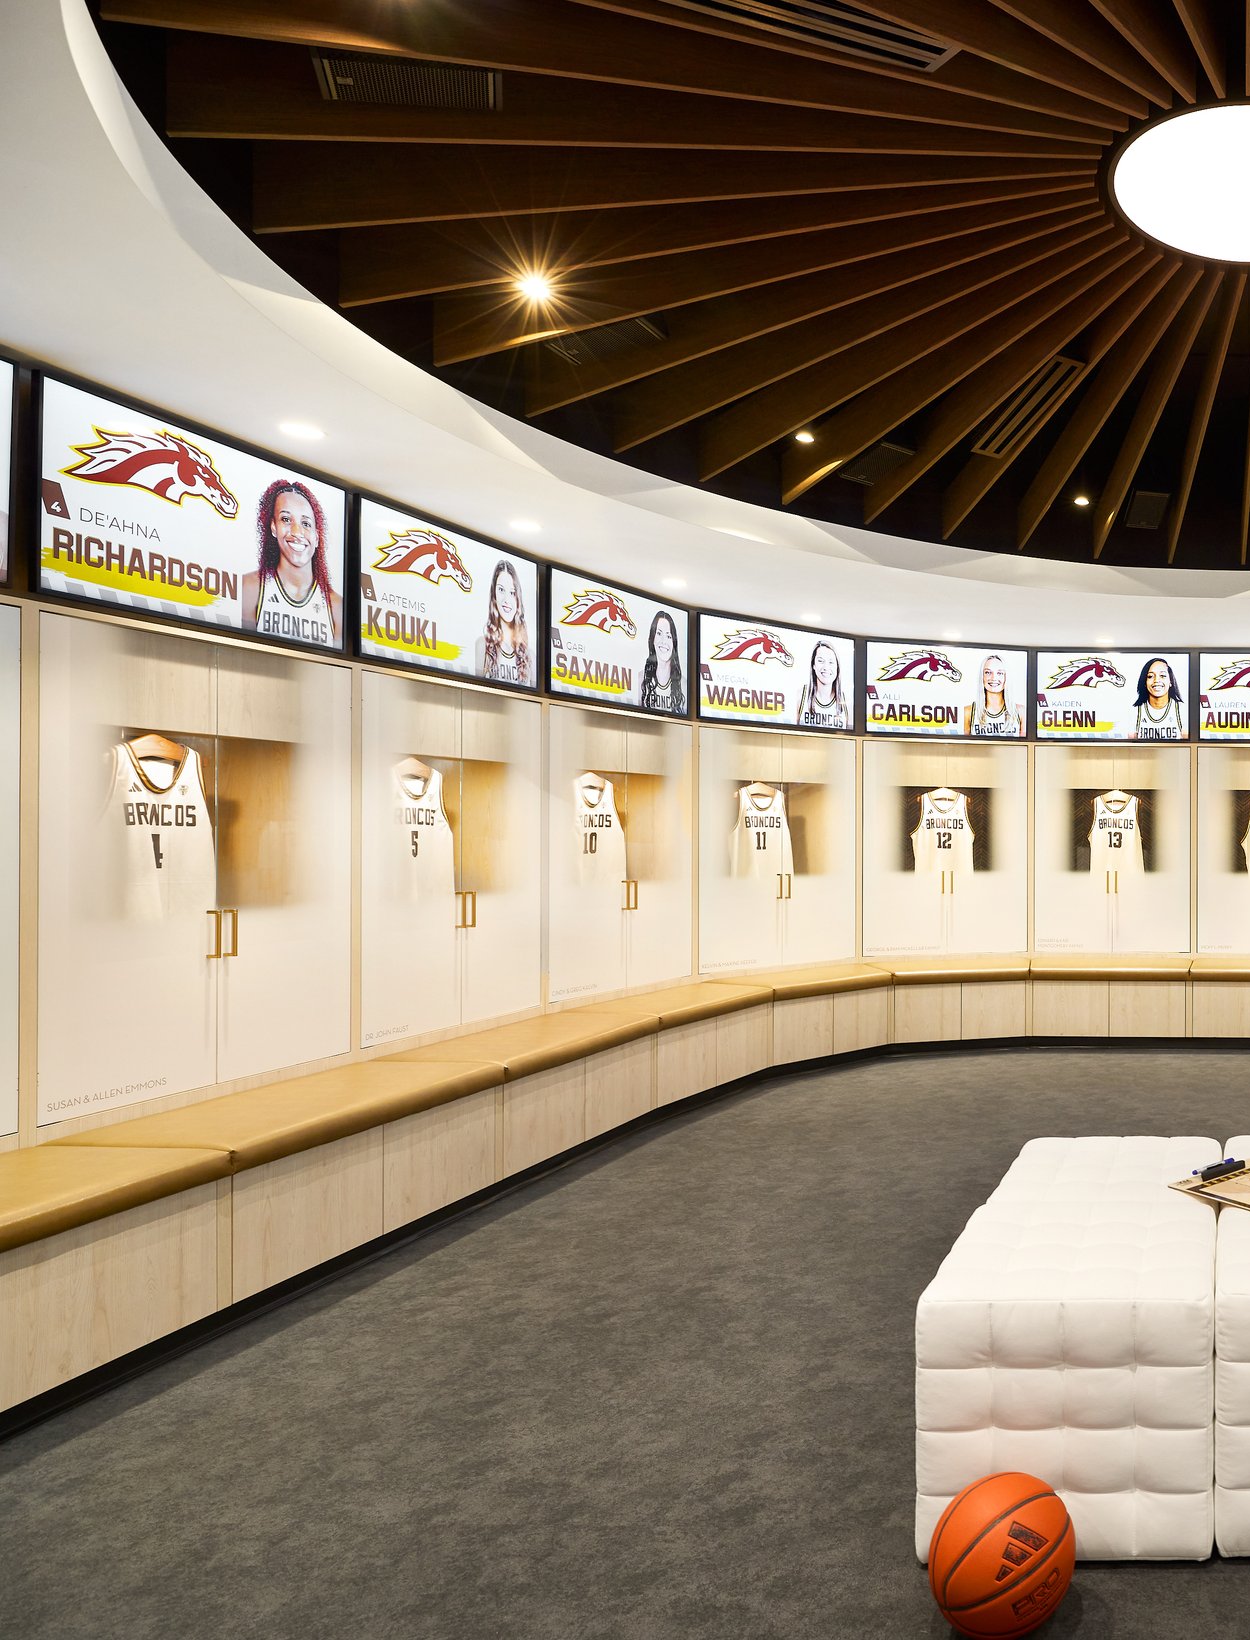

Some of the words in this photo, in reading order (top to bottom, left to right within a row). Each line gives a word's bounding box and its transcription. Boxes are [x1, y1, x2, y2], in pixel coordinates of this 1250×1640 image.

[49, 499, 63, 514] 4
[79, 507, 161, 542] DE'AHNA
[52, 526, 238, 601] RICHARDSON
[365, 588, 373, 598] 5
[380, 592, 426, 614] ARTEMIS
[262, 610, 328, 644] BRONCOS
[367, 604, 437, 651] KOUKI
[566, 641, 586, 653] GABI
[555, 653, 632, 691] SAXMAN
[706, 684, 785, 712] WAGNER
[1214, 701, 1247, 709] LAUREN
[803, 711, 844, 728] BRONCOS
[872, 703, 958, 724] CARLSON
[1041, 710, 1096, 728] GLENN
[1140, 727, 1177, 739] BRONCOS
[123, 802, 197, 827] BRNCOS
[394, 807, 436, 826] RONCOS
[579, 814, 612, 828] ONCOS
[925, 818, 964, 830] BRONCOS
[1098, 817, 1134, 830] BRONCOS
[411, 830, 419, 858] 5
[583, 832, 598, 854] 10
[755, 831, 767, 850] 11
[936, 831, 952, 849] 12
[1107, 831, 1123, 849] 13
[46, 1096, 81, 1112] SUSAN
[82, 1094, 90, 1104] &
[92, 1087, 123, 1102] ALLEN
[125, 1077, 167, 1094] EMMONS
